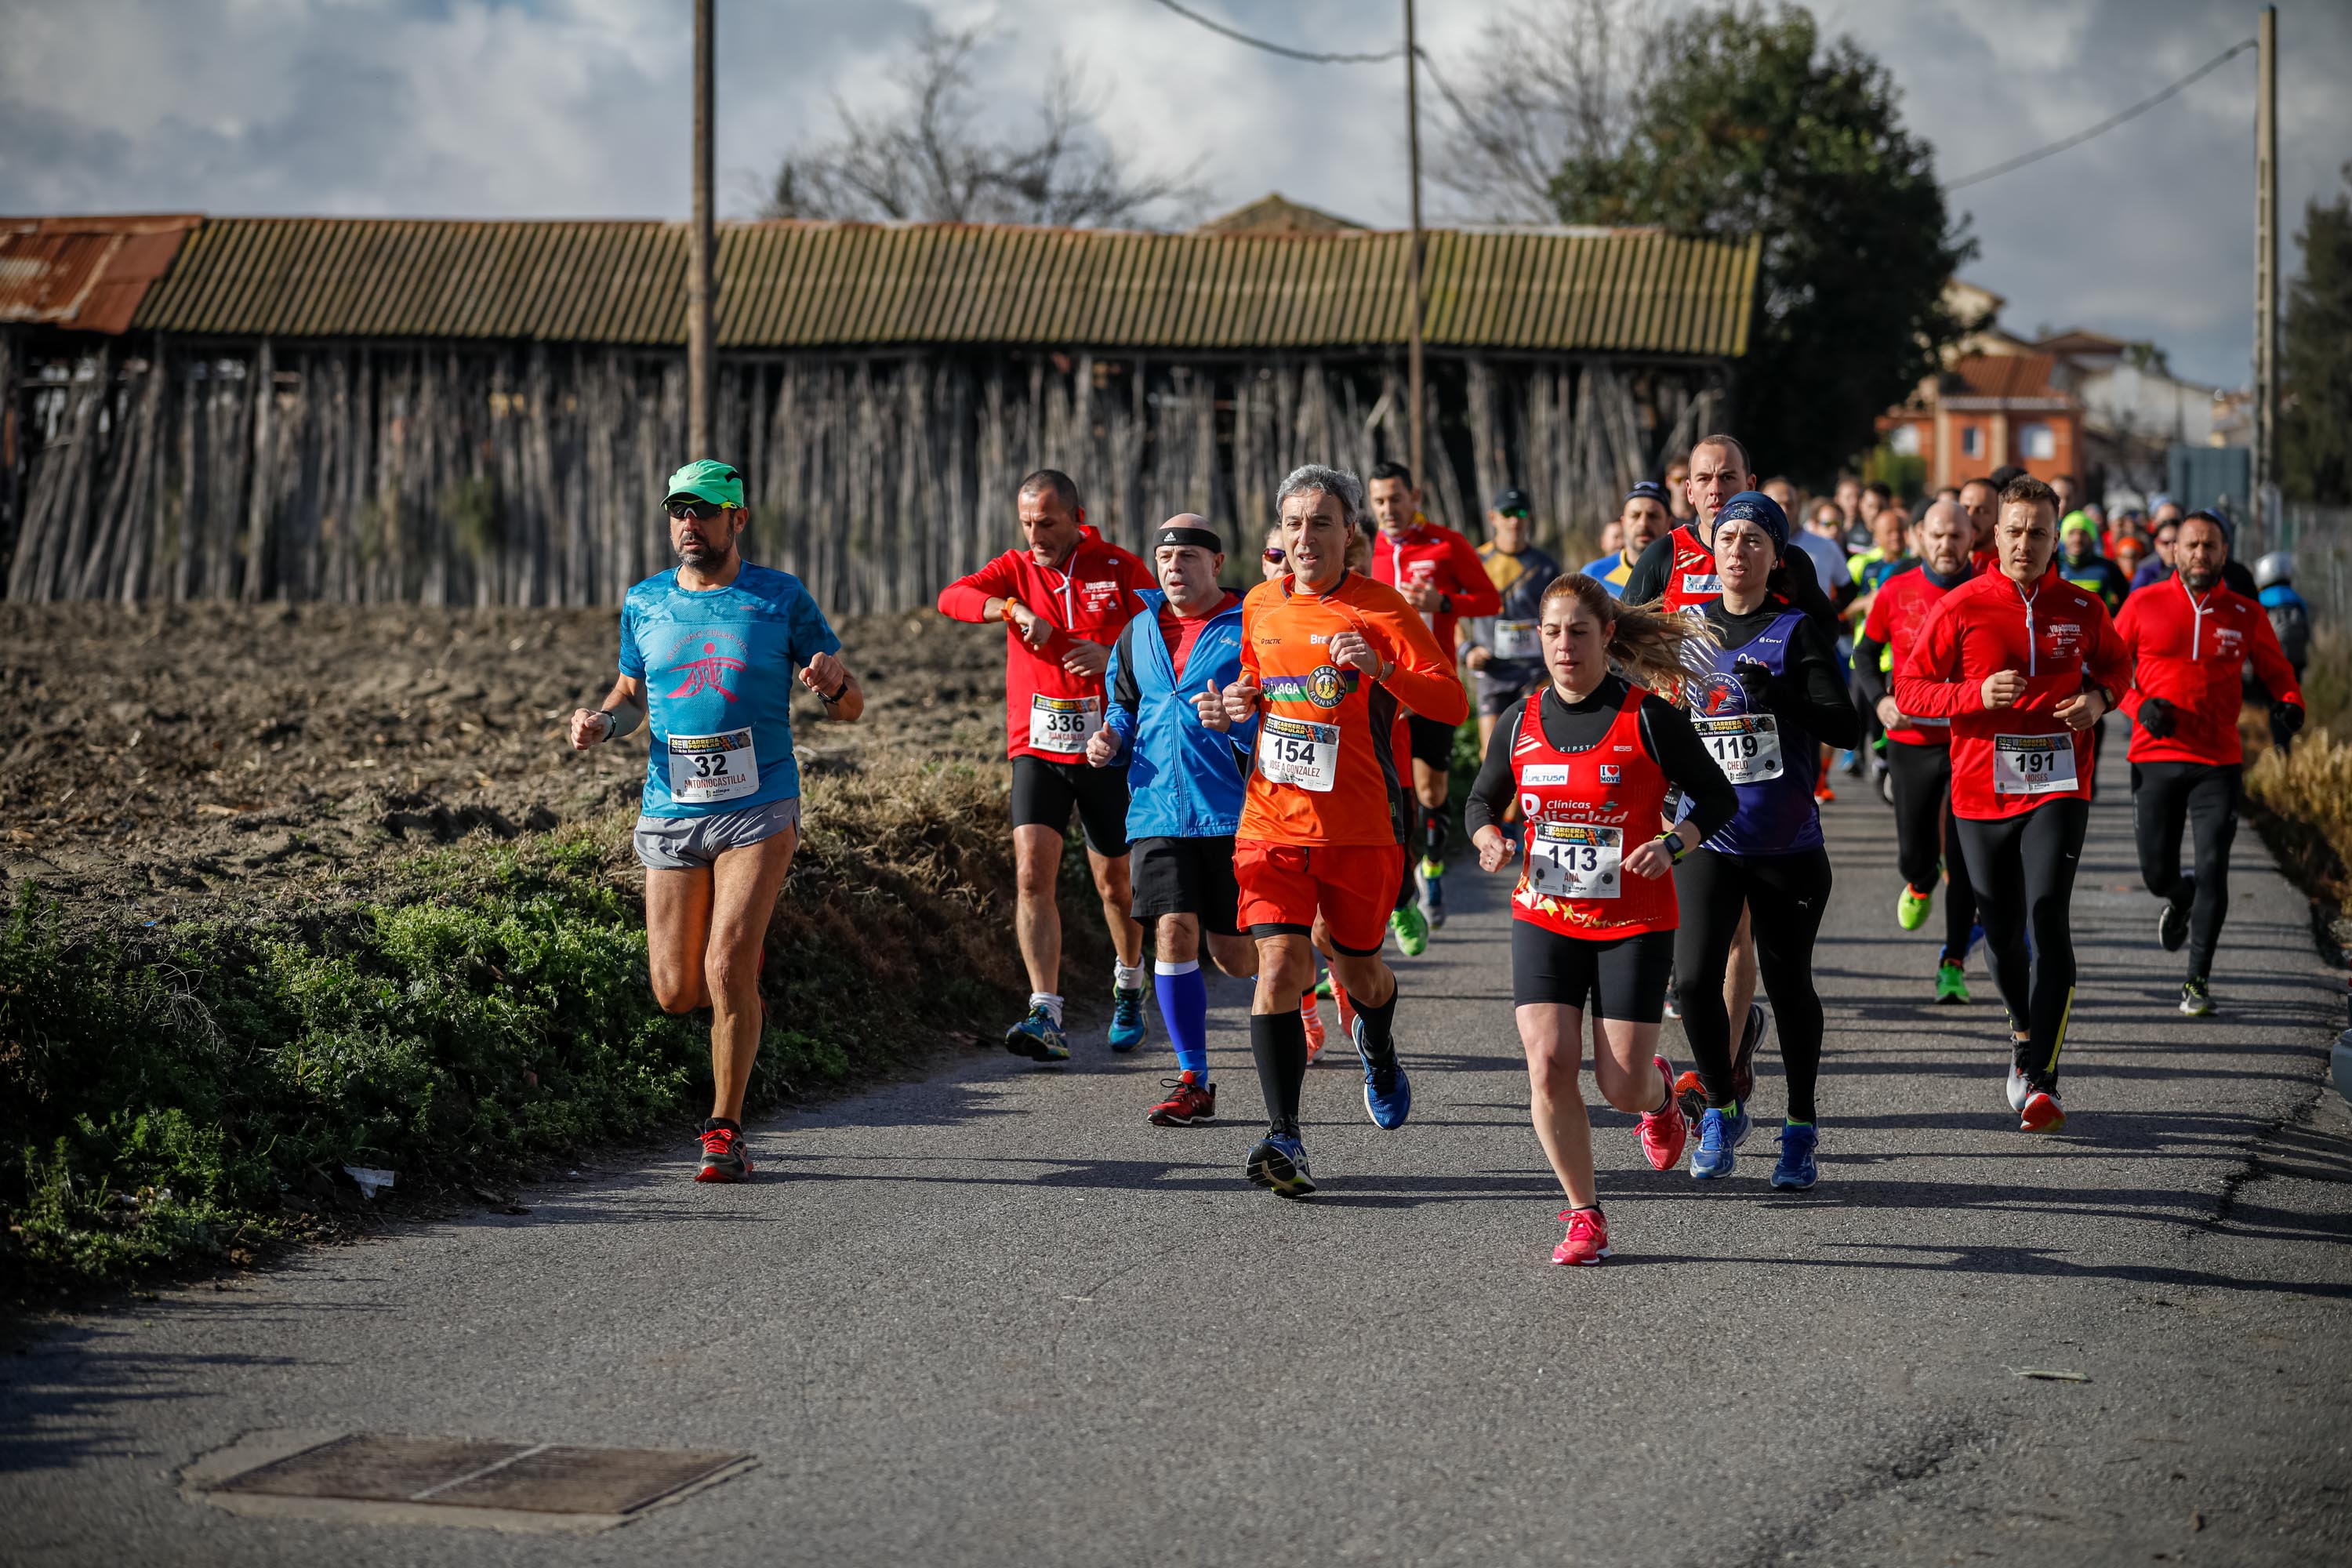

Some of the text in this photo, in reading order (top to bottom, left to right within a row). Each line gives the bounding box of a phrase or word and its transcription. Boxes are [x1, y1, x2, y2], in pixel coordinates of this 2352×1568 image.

[1314, 667, 1338, 677] BEER
[1309, 689, 1345, 706] RUNNERS
[1047, 713, 1085, 732] 336
[1278, 720, 1305, 730] CARRERA
[1278, 725, 1305, 735] POPULAR
[1274, 738, 1315, 765] 154
[1713, 735, 1759, 760] 119
[695, 753, 728, 777] 32
[1269, 760, 1280, 771] JOSE
[1281, 763, 1286, 772] A
[1287, 764, 1320, 778] GONZALEZ
[1727, 760, 1748, 771] CHELO
[2015, 752, 2054, 772] 191
[1602, 766, 1606, 775] I
[684, 773, 746, 789] ANTONIOCASTILLA
[1546, 800, 1591, 809] Clínicas
[1552, 826, 1585, 834] CARRERA
[1548, 845, 1597, 872] 113
[1563, 872, 1579, 882] ANA
